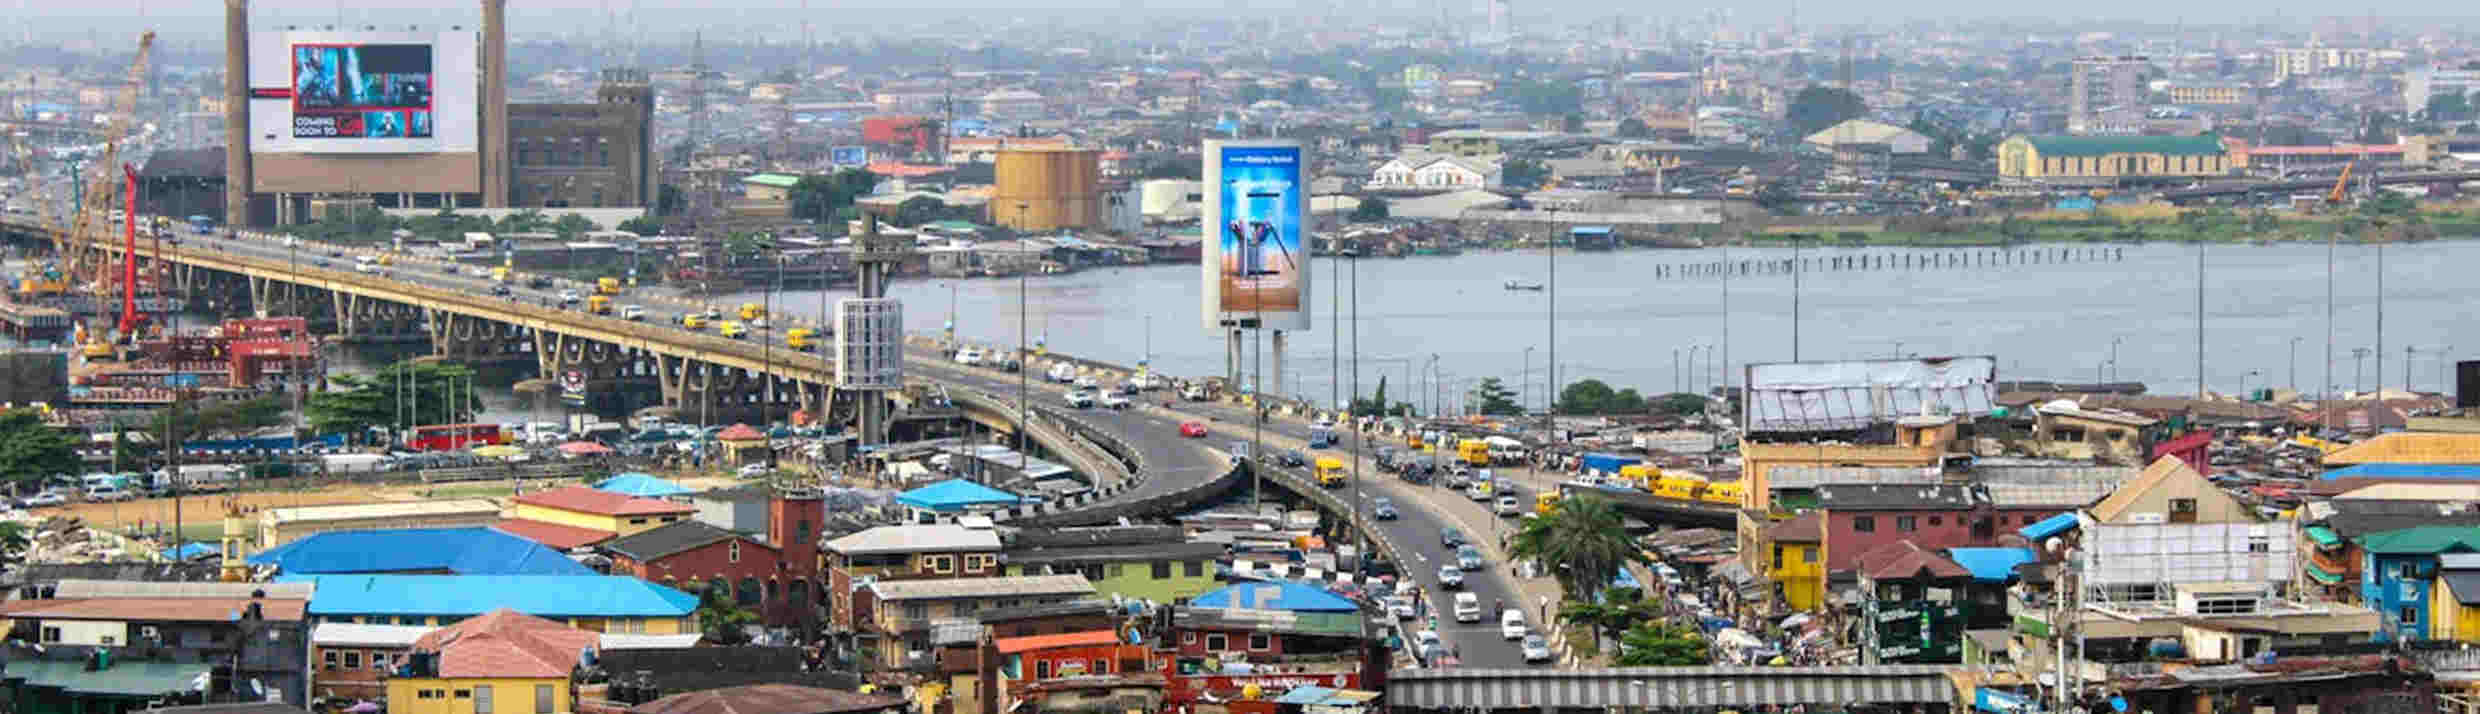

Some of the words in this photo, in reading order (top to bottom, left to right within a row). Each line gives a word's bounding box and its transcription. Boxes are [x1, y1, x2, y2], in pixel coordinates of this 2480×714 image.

[295, 116, 335, 126] COMING
[295, 127, 321, 135] SOON
[323, 127, 337, 135] TO
